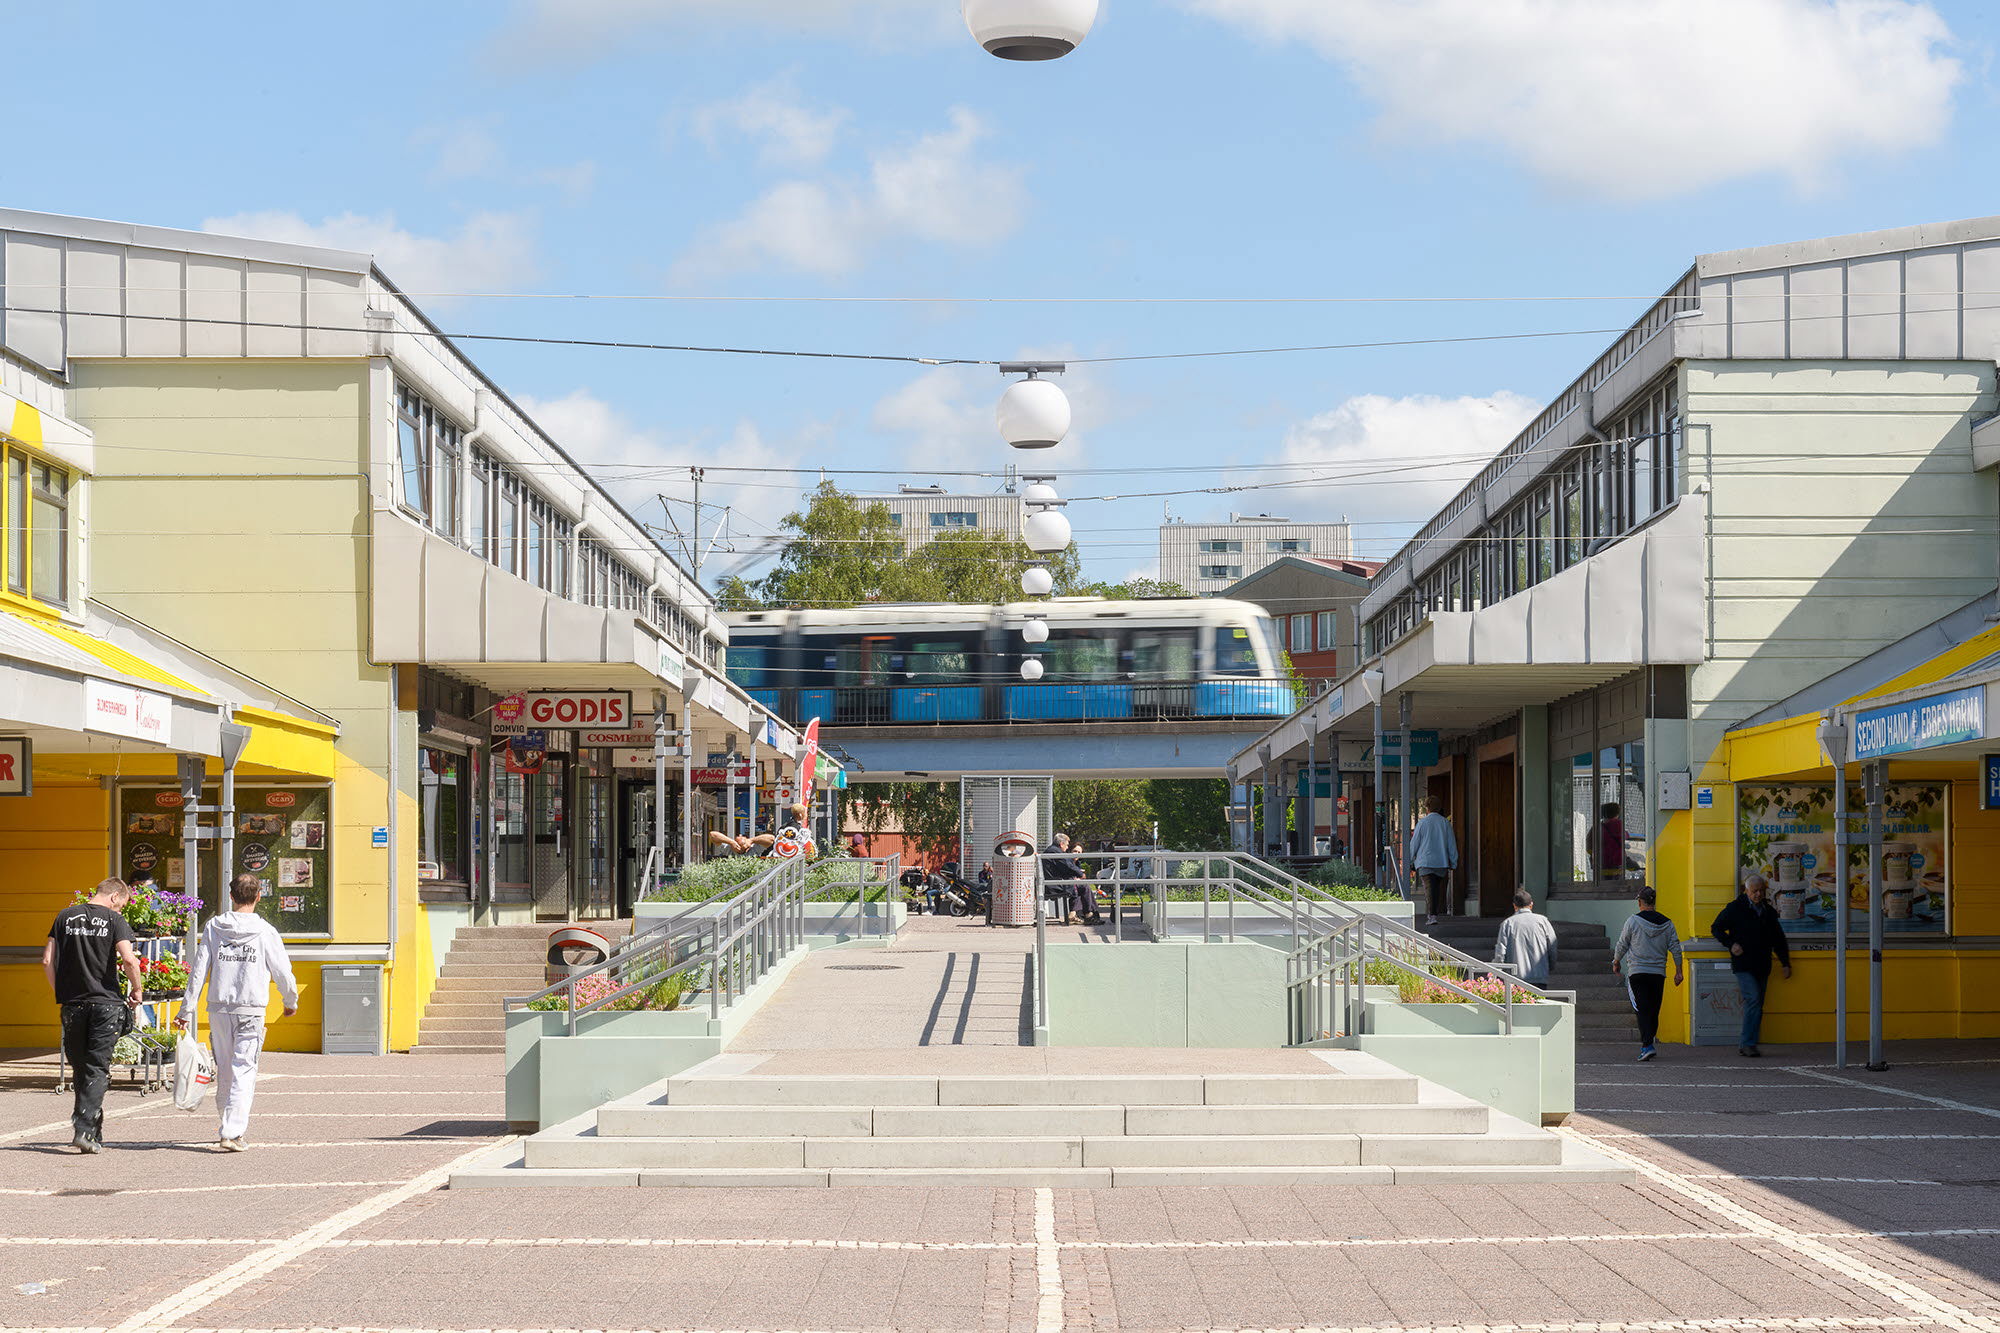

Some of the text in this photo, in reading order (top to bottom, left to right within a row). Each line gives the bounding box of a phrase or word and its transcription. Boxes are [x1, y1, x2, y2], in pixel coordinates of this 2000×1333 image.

[531, 698, 623, 722] GODIS
[494, 724, 525, 733] COMVIQ
[1857, 716, 1887, 752] SECOND
[1887, 712, 1909, 746] HAND
[1921, 703, 1948, 739] EBBES
[587, 733, 656, 743] COSMETIC
[1386, 735, 1433, 744] Banomat
[1783, 823, 1797, 834] ÄR
[91, 917, 108, 928] City
[97, 927, 109, 937] AB
[243, 945, 256, 954] City
[248, 955, 257, 963] AB
